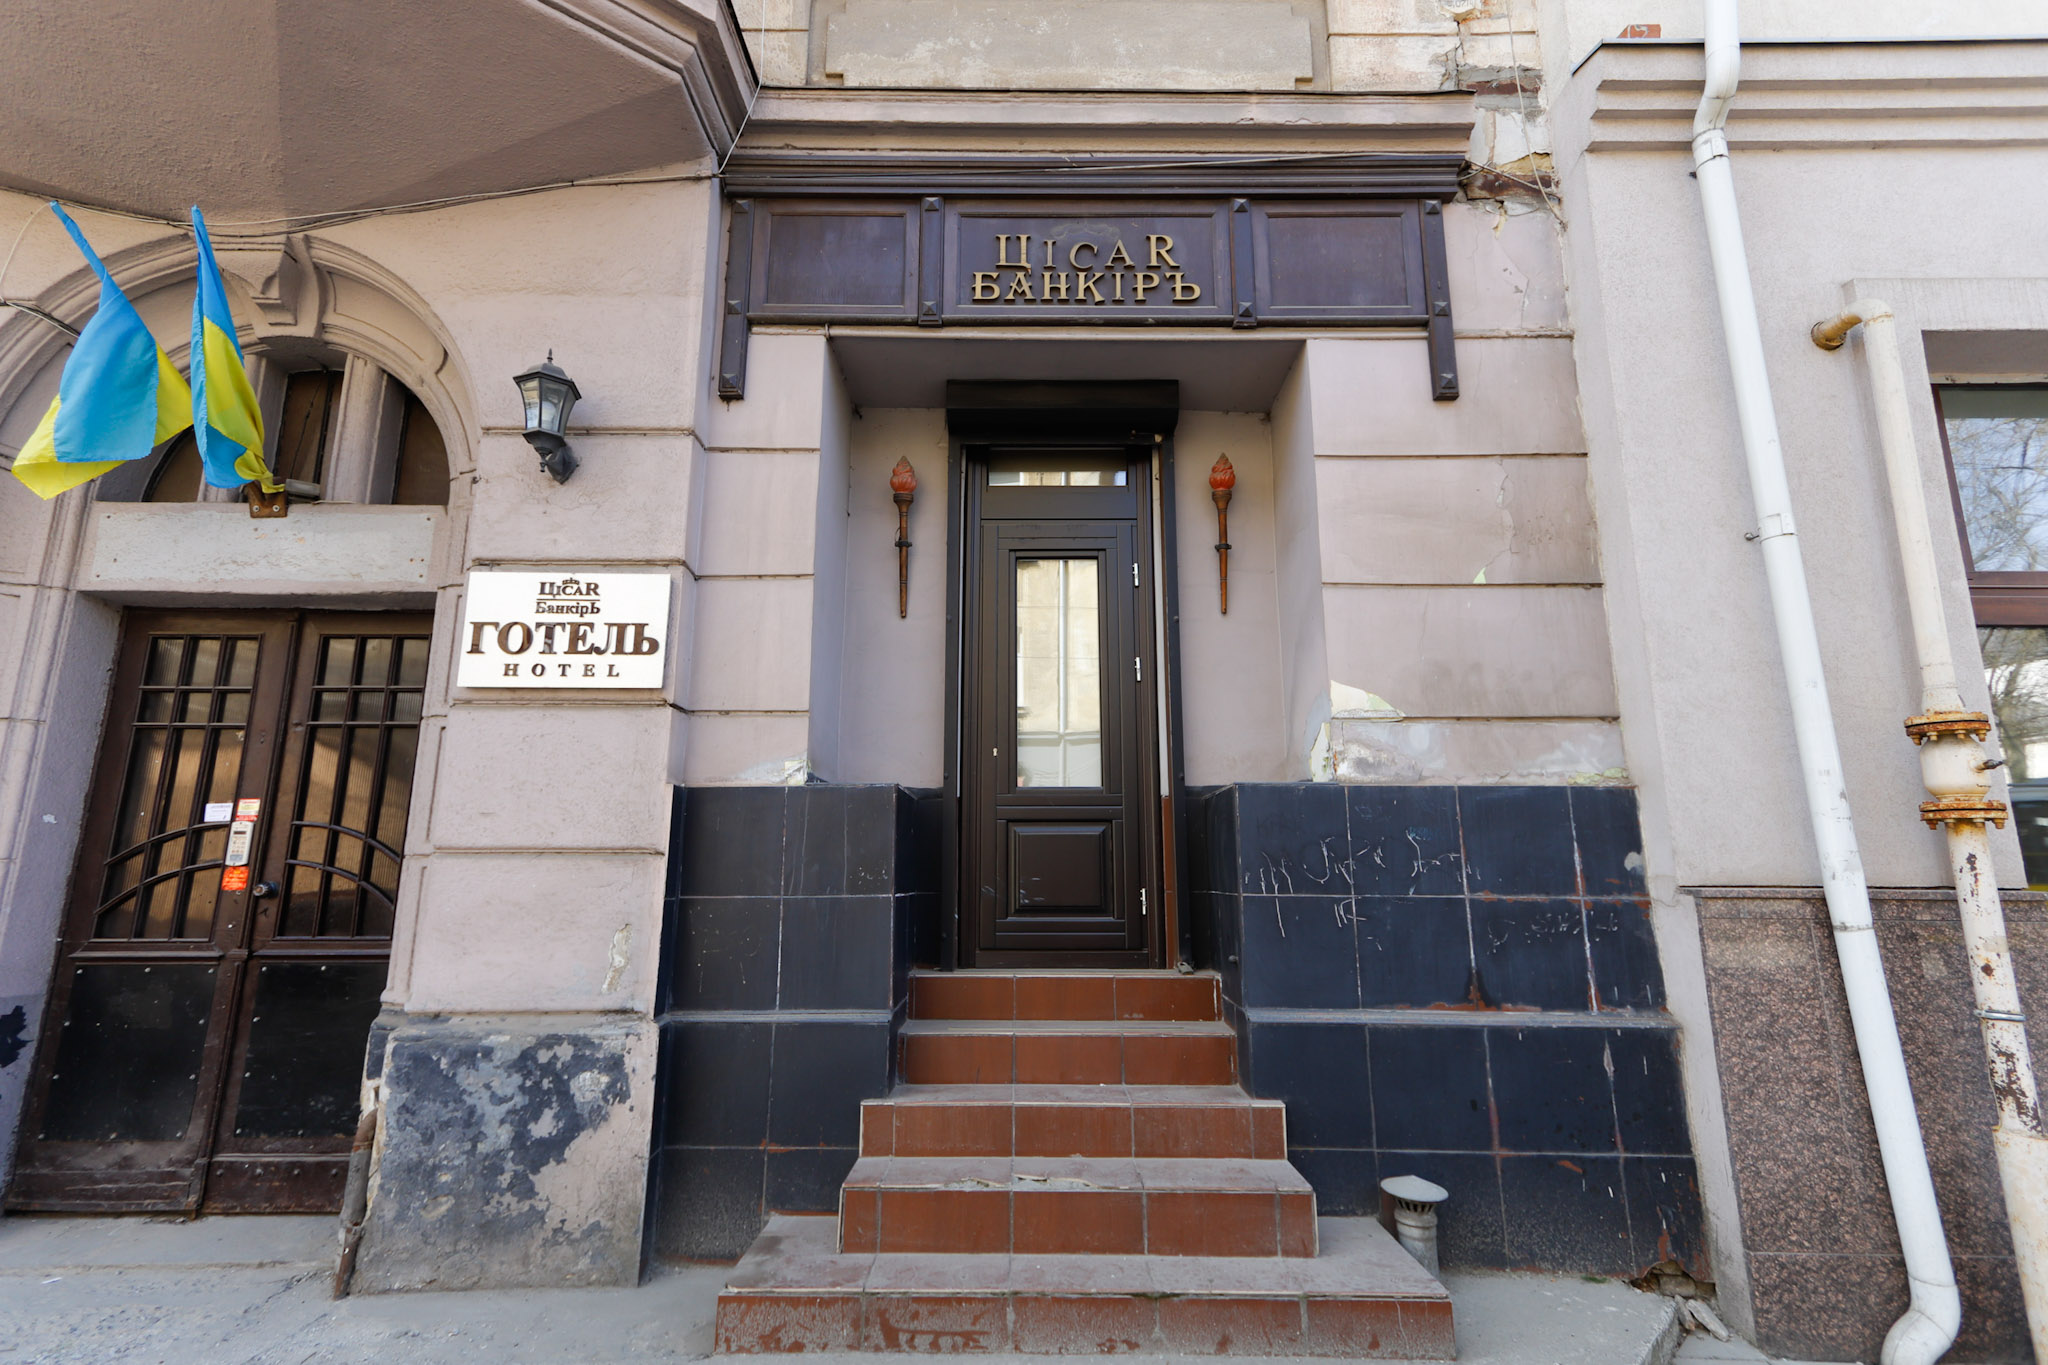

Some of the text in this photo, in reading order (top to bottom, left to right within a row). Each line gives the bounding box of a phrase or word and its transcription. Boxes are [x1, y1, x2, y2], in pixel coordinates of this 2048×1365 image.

[971, 271, 1201, 303] БАНКІРЪ
[466, 621, 660, 656] ГОТЕЛЬ
[503, 663, 620, 677] HOTEL
